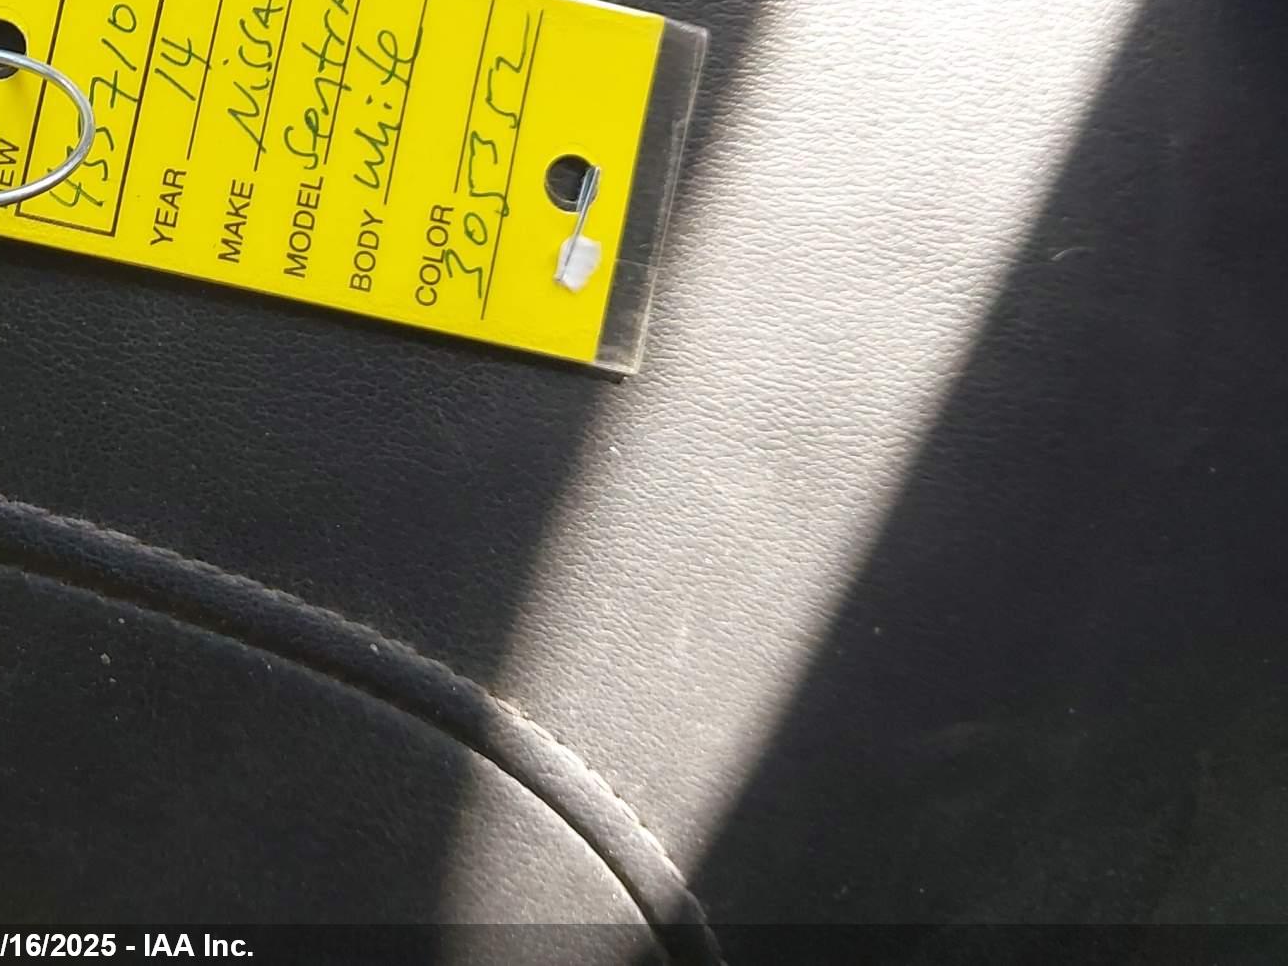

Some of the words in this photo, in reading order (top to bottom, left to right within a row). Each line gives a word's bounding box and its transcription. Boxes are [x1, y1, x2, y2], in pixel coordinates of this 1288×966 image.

[155, 37, 212, 101] 14
[150, 168, 187, 246] YEAR
[218, 179, 255, 264] MAKE
[283, 175, 325, 279] MODEL
[349, 209, 385, 293] BODY
[415, 203, 455, 307] COLOR
